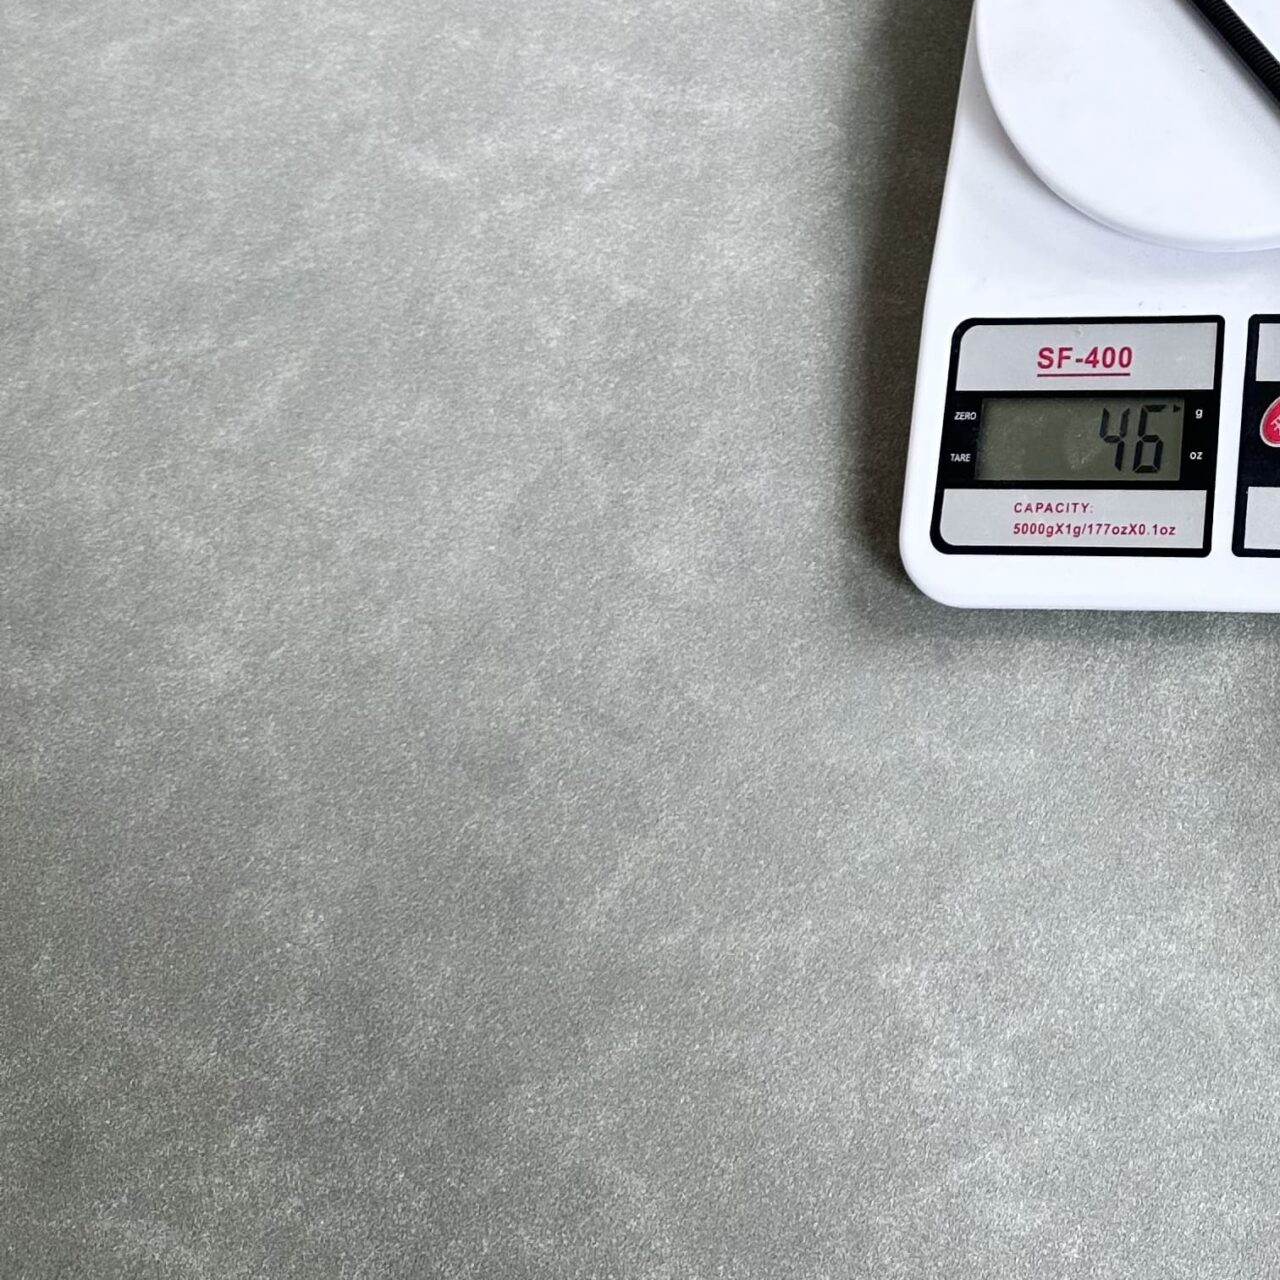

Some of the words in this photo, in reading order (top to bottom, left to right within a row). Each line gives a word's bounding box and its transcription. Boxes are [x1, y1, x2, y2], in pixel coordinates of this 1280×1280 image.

[1037, 346, 1132, 369] SF-400
[954, 411, 977, 421] ZERO
[1195, 409, 1203, 419] g
[1099, 404, 1167, 474] 46
[950, 452, 971, 462] TARE
[1190, 451, 1203, 460] oz
[1013, 502, 1094, 514] CAPACITY:
[1013, 522, 1176, 538] 5000gX1g/177ozX0.1oz
